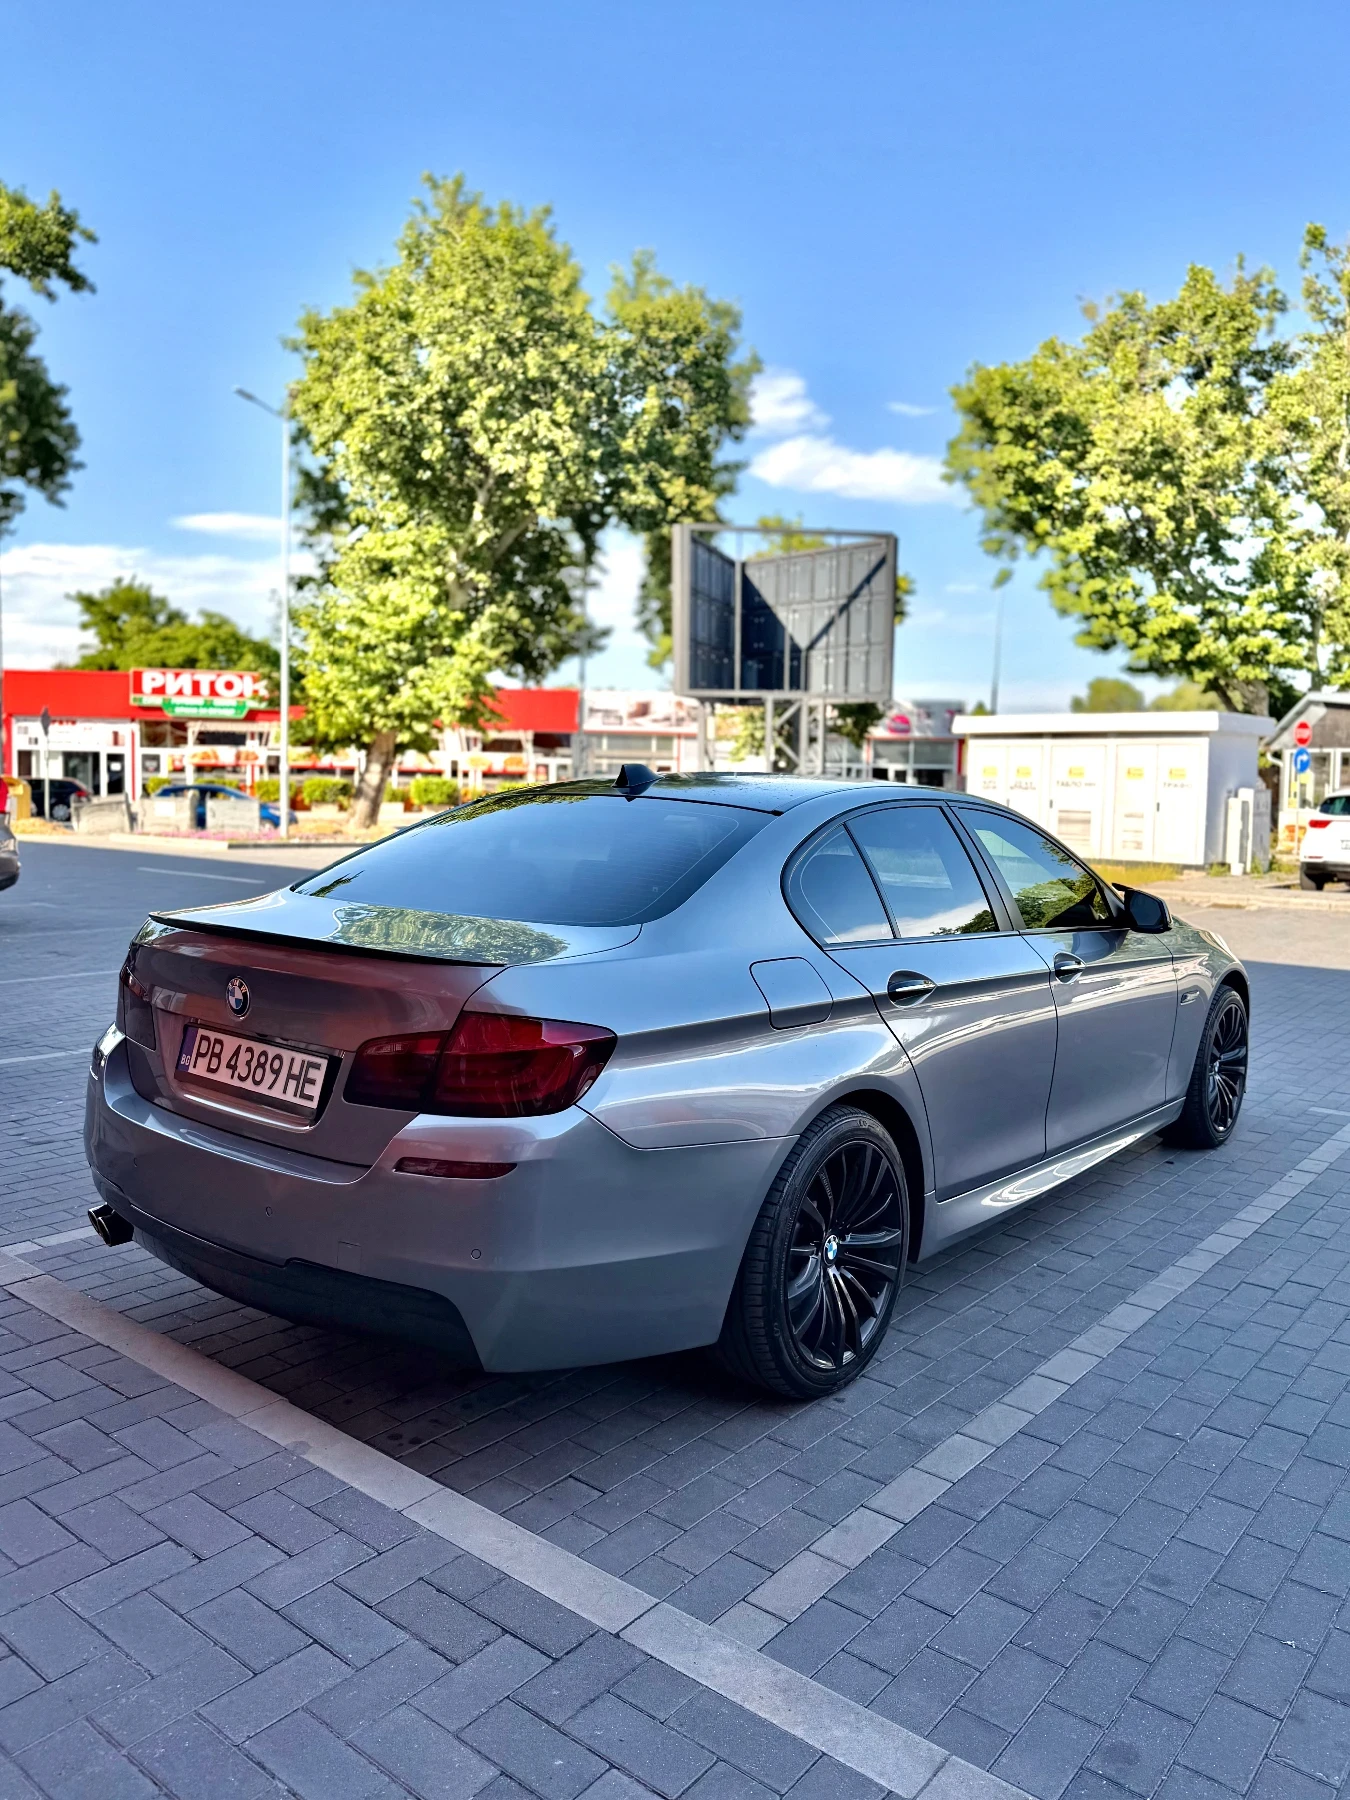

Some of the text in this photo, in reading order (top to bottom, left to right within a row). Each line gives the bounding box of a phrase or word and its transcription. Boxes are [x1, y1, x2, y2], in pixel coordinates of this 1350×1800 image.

[141, 671, 269, 698] РИТОК
[181, 1054, 190, 1066] BG
[226, 1044, 284, 1090] 4389
